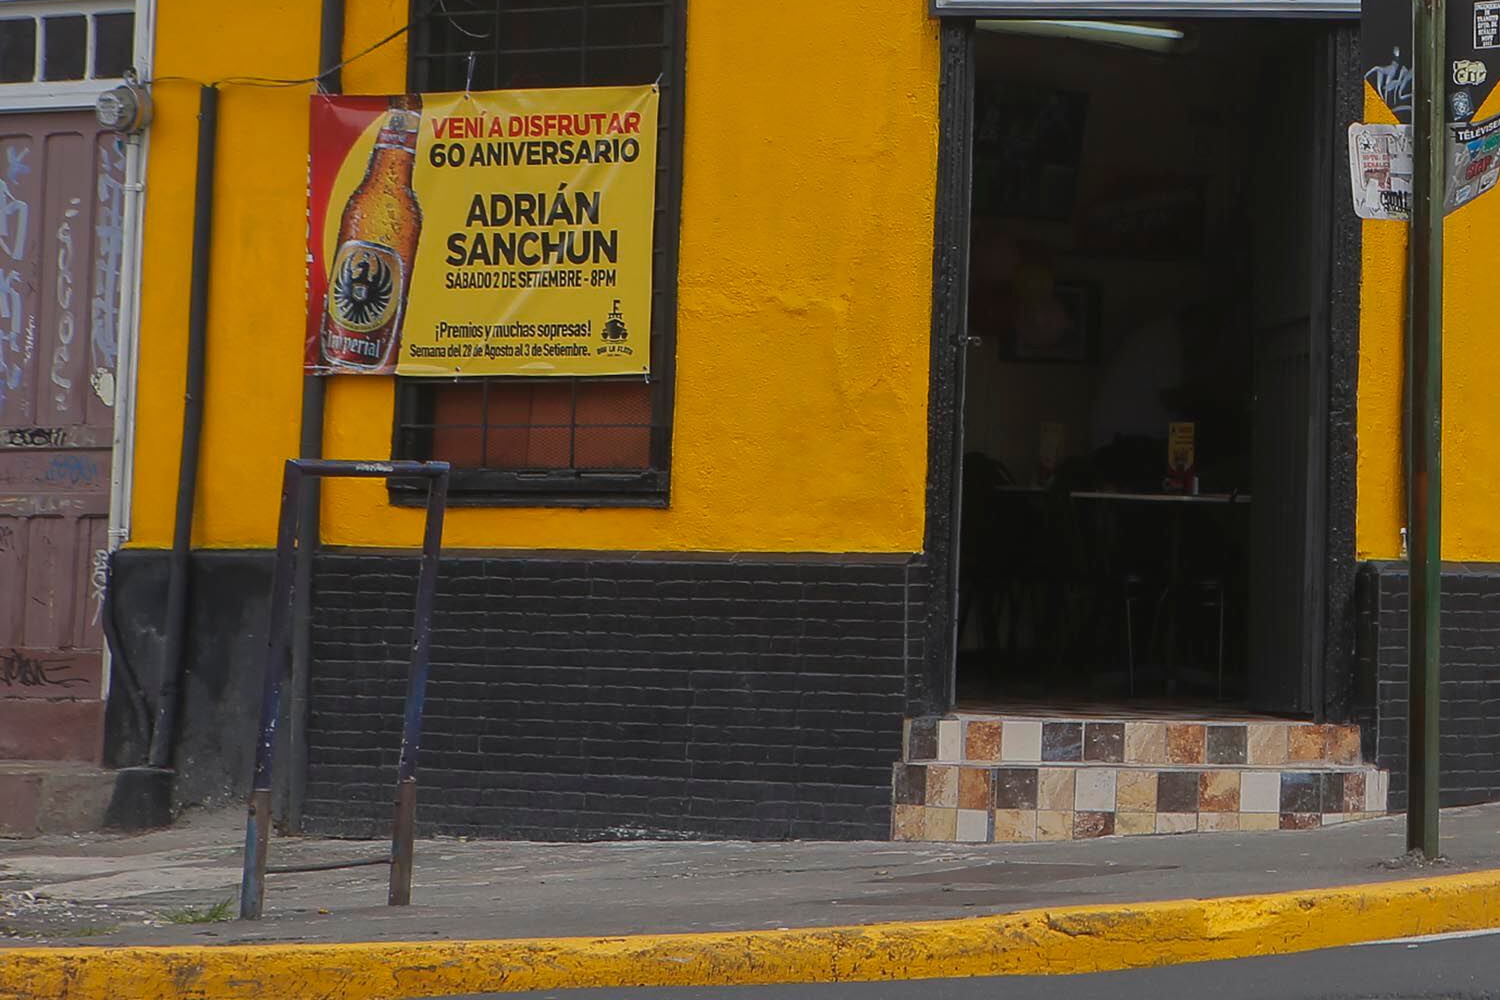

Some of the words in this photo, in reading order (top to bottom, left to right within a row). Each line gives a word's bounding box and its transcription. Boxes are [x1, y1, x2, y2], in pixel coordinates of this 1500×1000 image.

[431, 110, 485, 140] VENÍ
[488, 115, 504, 138] A
[508, 111, 642, 138] DISFRUTAR
[429, 142, 466, 168] 60
[469, 137, 641, 168] ANIVERSARIO
[465, 182, 600, 228] ADRIÁN
[446, 230, 618, 267] SANCHUN
[446, 269, 492, 290] SÁBADO
[493, 272, 500, 289] 2
[503, 271, 516, 288] DE
[518, 270, 582, 288] SETIEMBRE
[590, 269, 617, 287] 8PM
[435, 321, 484, 342] ¡Premios
[484, 328, 492, 342] y
[492, 320, 536, 338] muchas
[537, 319, 592, 342] sopresas!
[409, 343, 446, 358] Semana
[447, 343, 461, 357] del
[473, 343, 483, 357] de
[485, 343, 514, 360] Agosto
[515, 342, 524, 357] al
[525, 343, 531, 357] 3
[532, 342, 543, 357] de
